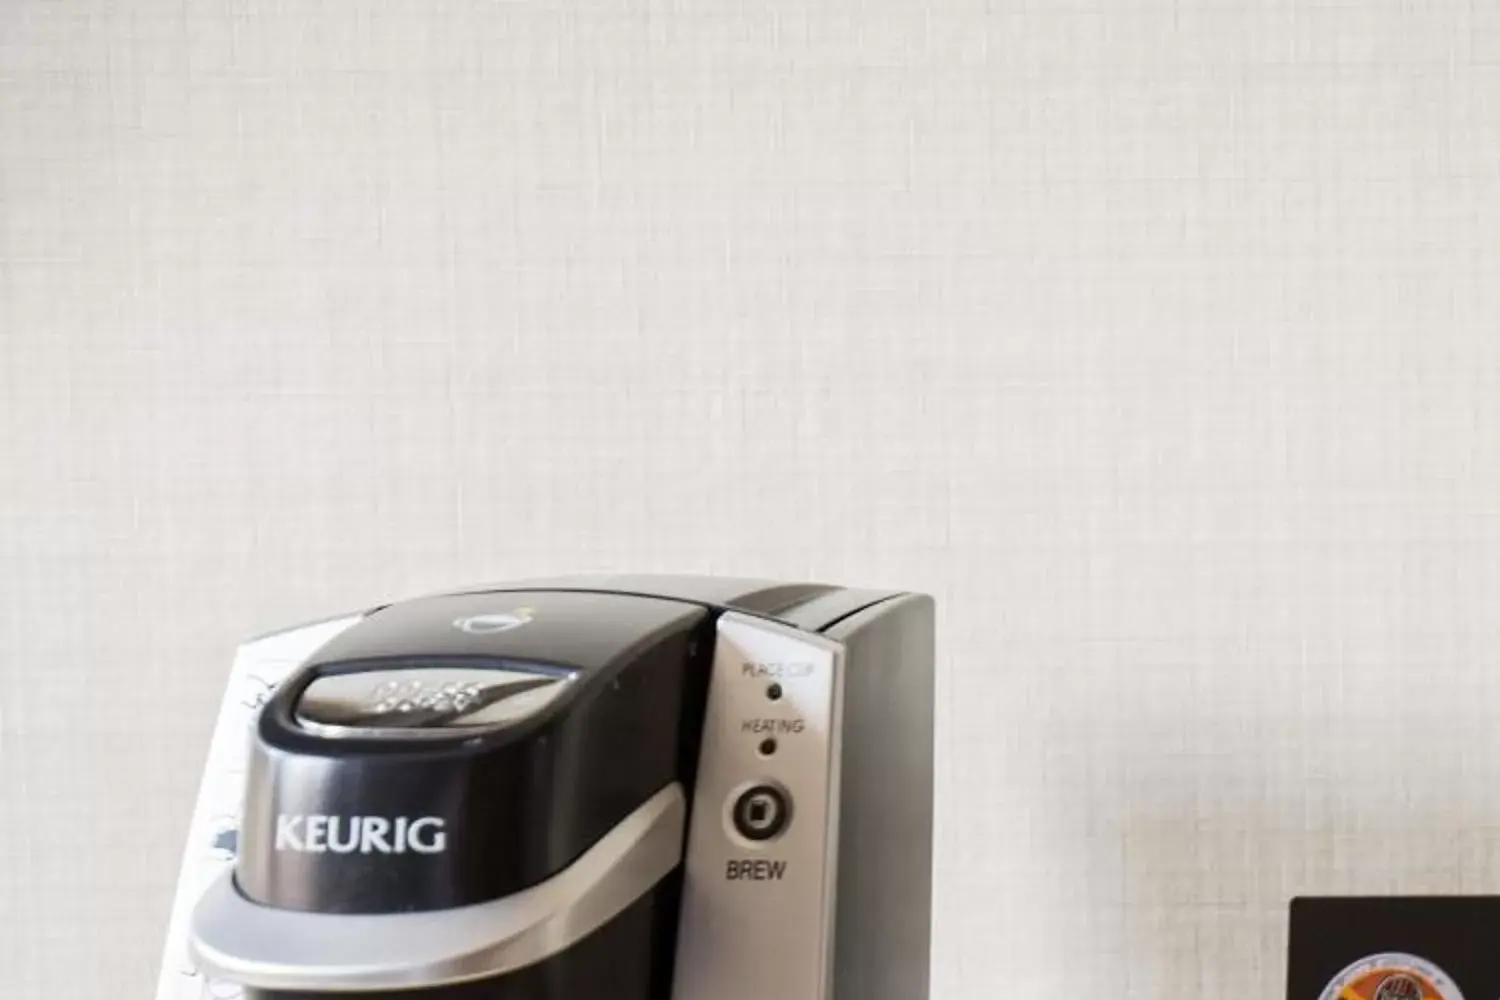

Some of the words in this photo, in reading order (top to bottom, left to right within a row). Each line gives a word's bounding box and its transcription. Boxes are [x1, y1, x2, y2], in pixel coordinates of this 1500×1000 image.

[742, 662, 784, 678] PLACE
[741, 718, 805, 734] HEATING
[275, 814, 447, 854] KEURIG
[726, 859, 787, 881] BREW
